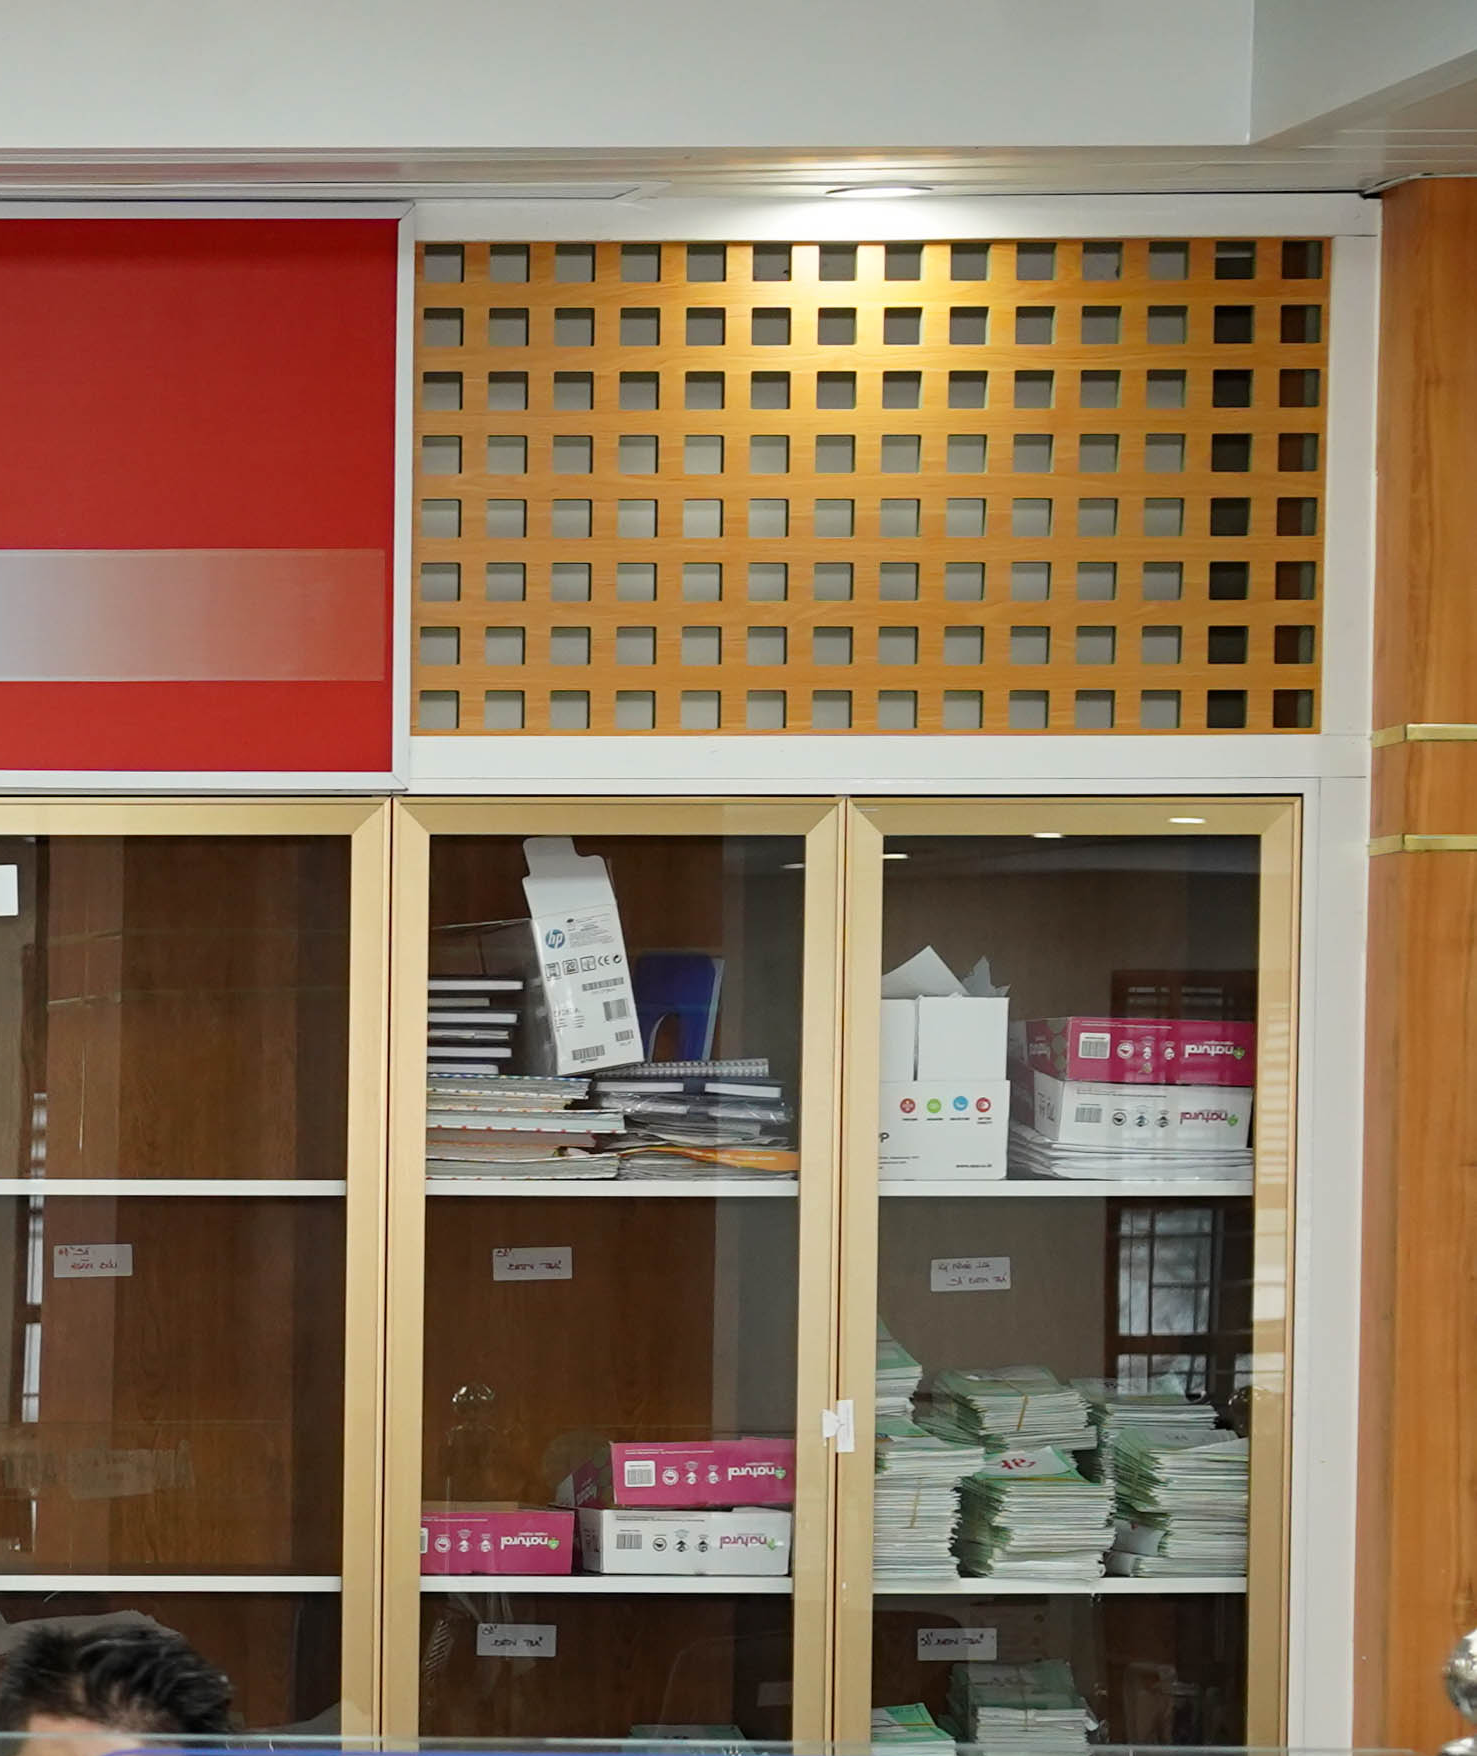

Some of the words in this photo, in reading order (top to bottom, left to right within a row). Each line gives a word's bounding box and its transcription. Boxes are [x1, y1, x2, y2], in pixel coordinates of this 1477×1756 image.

[546, 929, 565, 949] hp
[1184, 1044, 1235, 1058] natural
[1180, 1110, 1229, 1125] natural
[727, 1465, 776, 1481] natural
[500, 1535, 549, 1550] natural
[720, 1534, 768, 1550] natural
